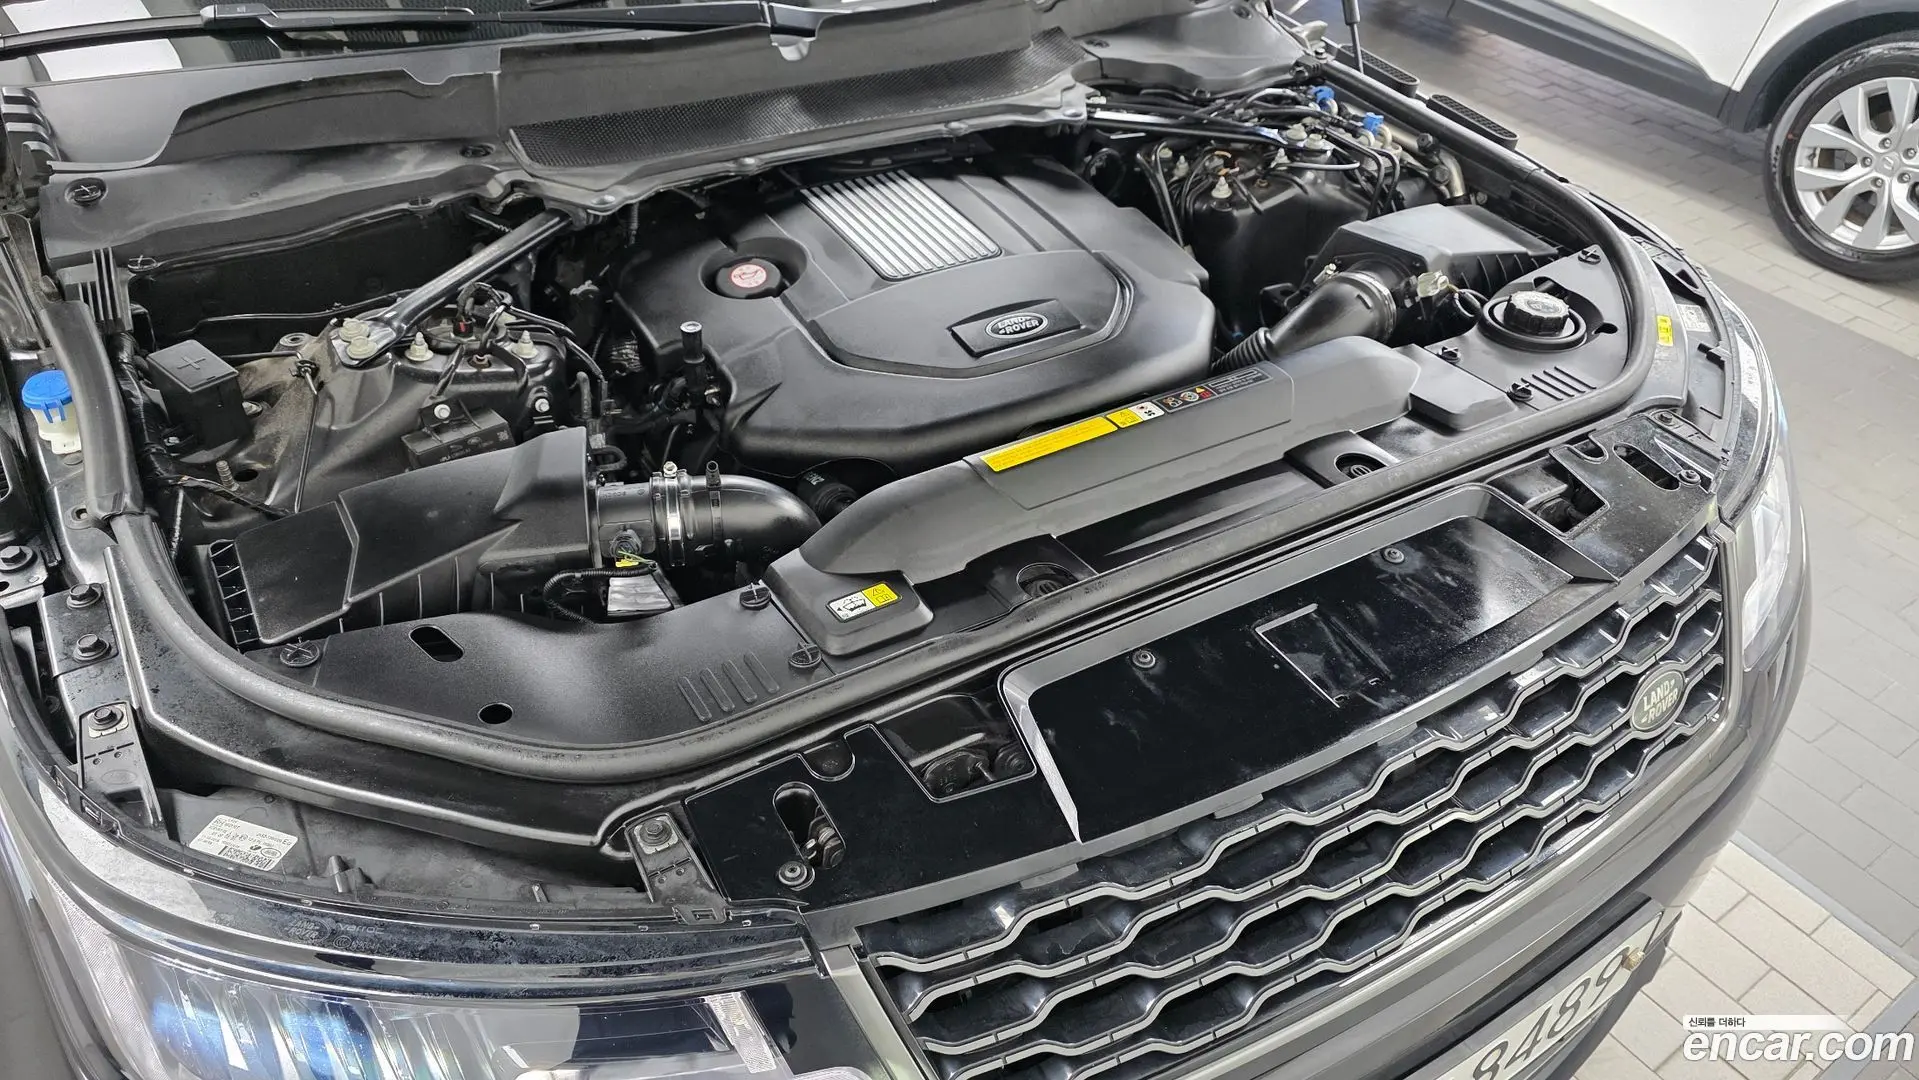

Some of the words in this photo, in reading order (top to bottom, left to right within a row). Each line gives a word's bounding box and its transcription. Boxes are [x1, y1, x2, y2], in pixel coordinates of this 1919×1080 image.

[998, 316, 1025, 329] LAND
[1006, 319, 1039, 334] ROVER
[1643, 680, 1670, 711] LAND
[1647, 688, 1678, 723] ROVER
